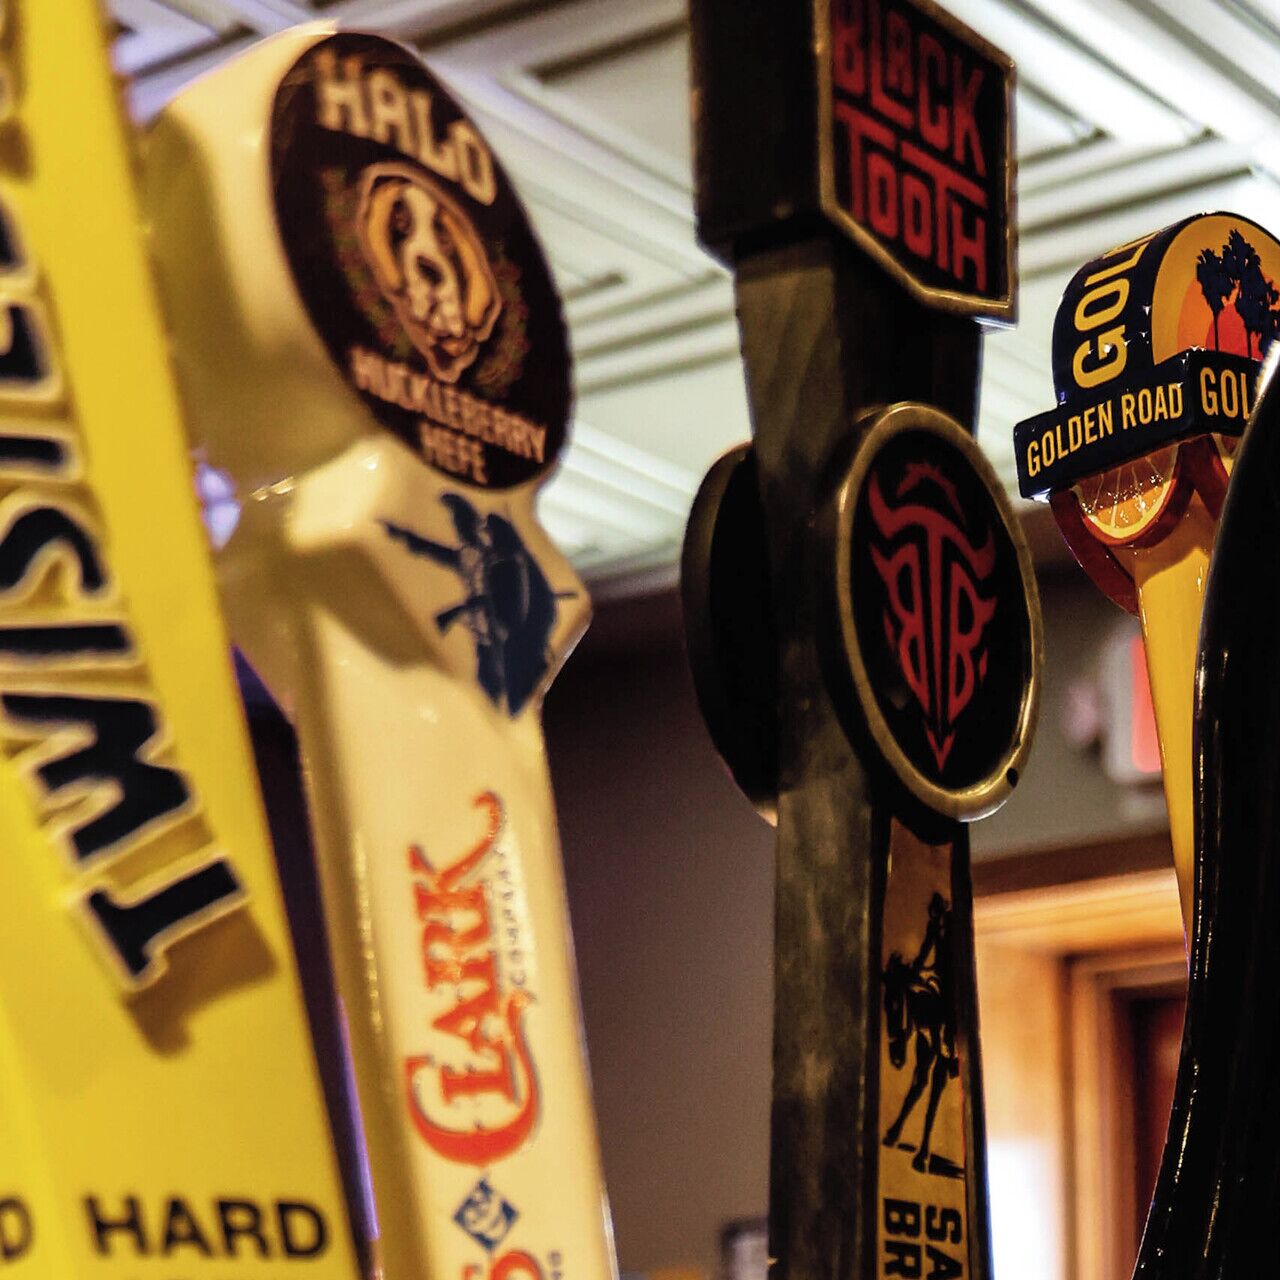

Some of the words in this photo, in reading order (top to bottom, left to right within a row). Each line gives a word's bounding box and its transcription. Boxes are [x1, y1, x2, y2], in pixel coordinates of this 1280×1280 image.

[312, 46, 497, 206] HALO
[833, 0, 987, 178] BLACK
[833, 100, 989, 292] TOOTH
[1072, 230, 1162, 390] GOL
[1026, 399, 1113, 478] GOLDEN
[1121, 382, 1184, 430] ROAD
[1200, 366, 1250, 420] GOL
[403, 790, 542, 1168] CLARK
[84, 1195, 330, 1258] HARD
